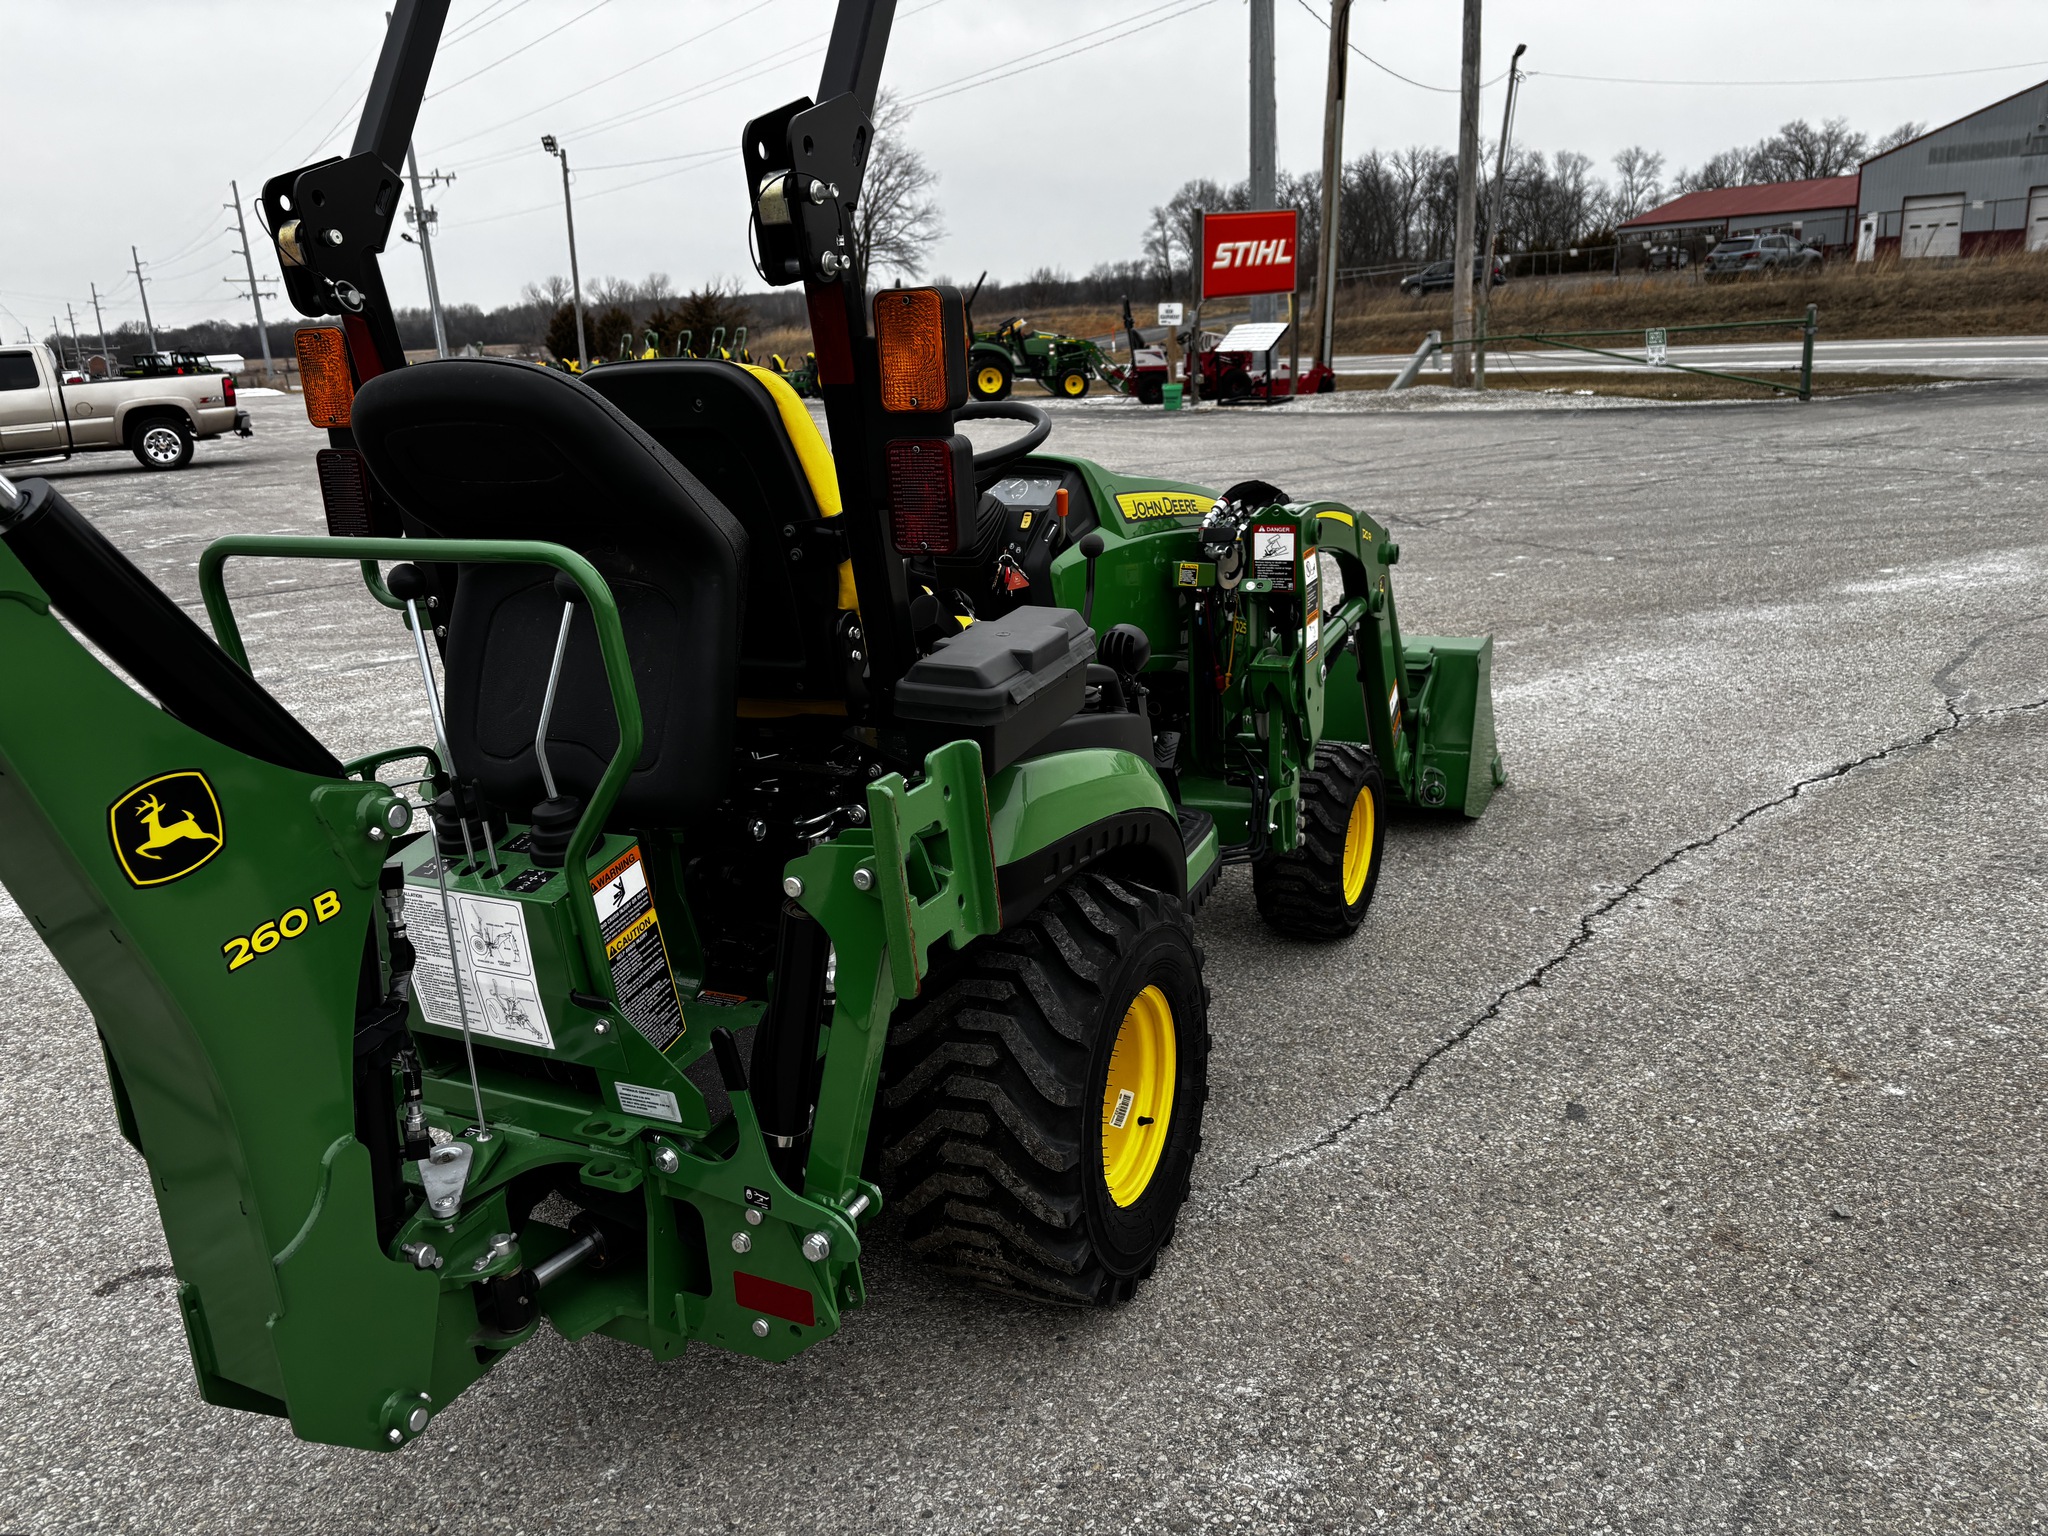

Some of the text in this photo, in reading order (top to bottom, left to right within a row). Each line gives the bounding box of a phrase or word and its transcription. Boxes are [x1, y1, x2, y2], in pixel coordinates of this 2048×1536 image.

[1212, 238, 1292, 270] STIHL
[1131, 497, 1199, 518] JOHN DEERE
[1235, 620, 1247, 635] 025
[597, 854, 635, 887] WARNING
[222, 889, 342, 972] 260 B
[616, 917, 651, 950] CAUTION
